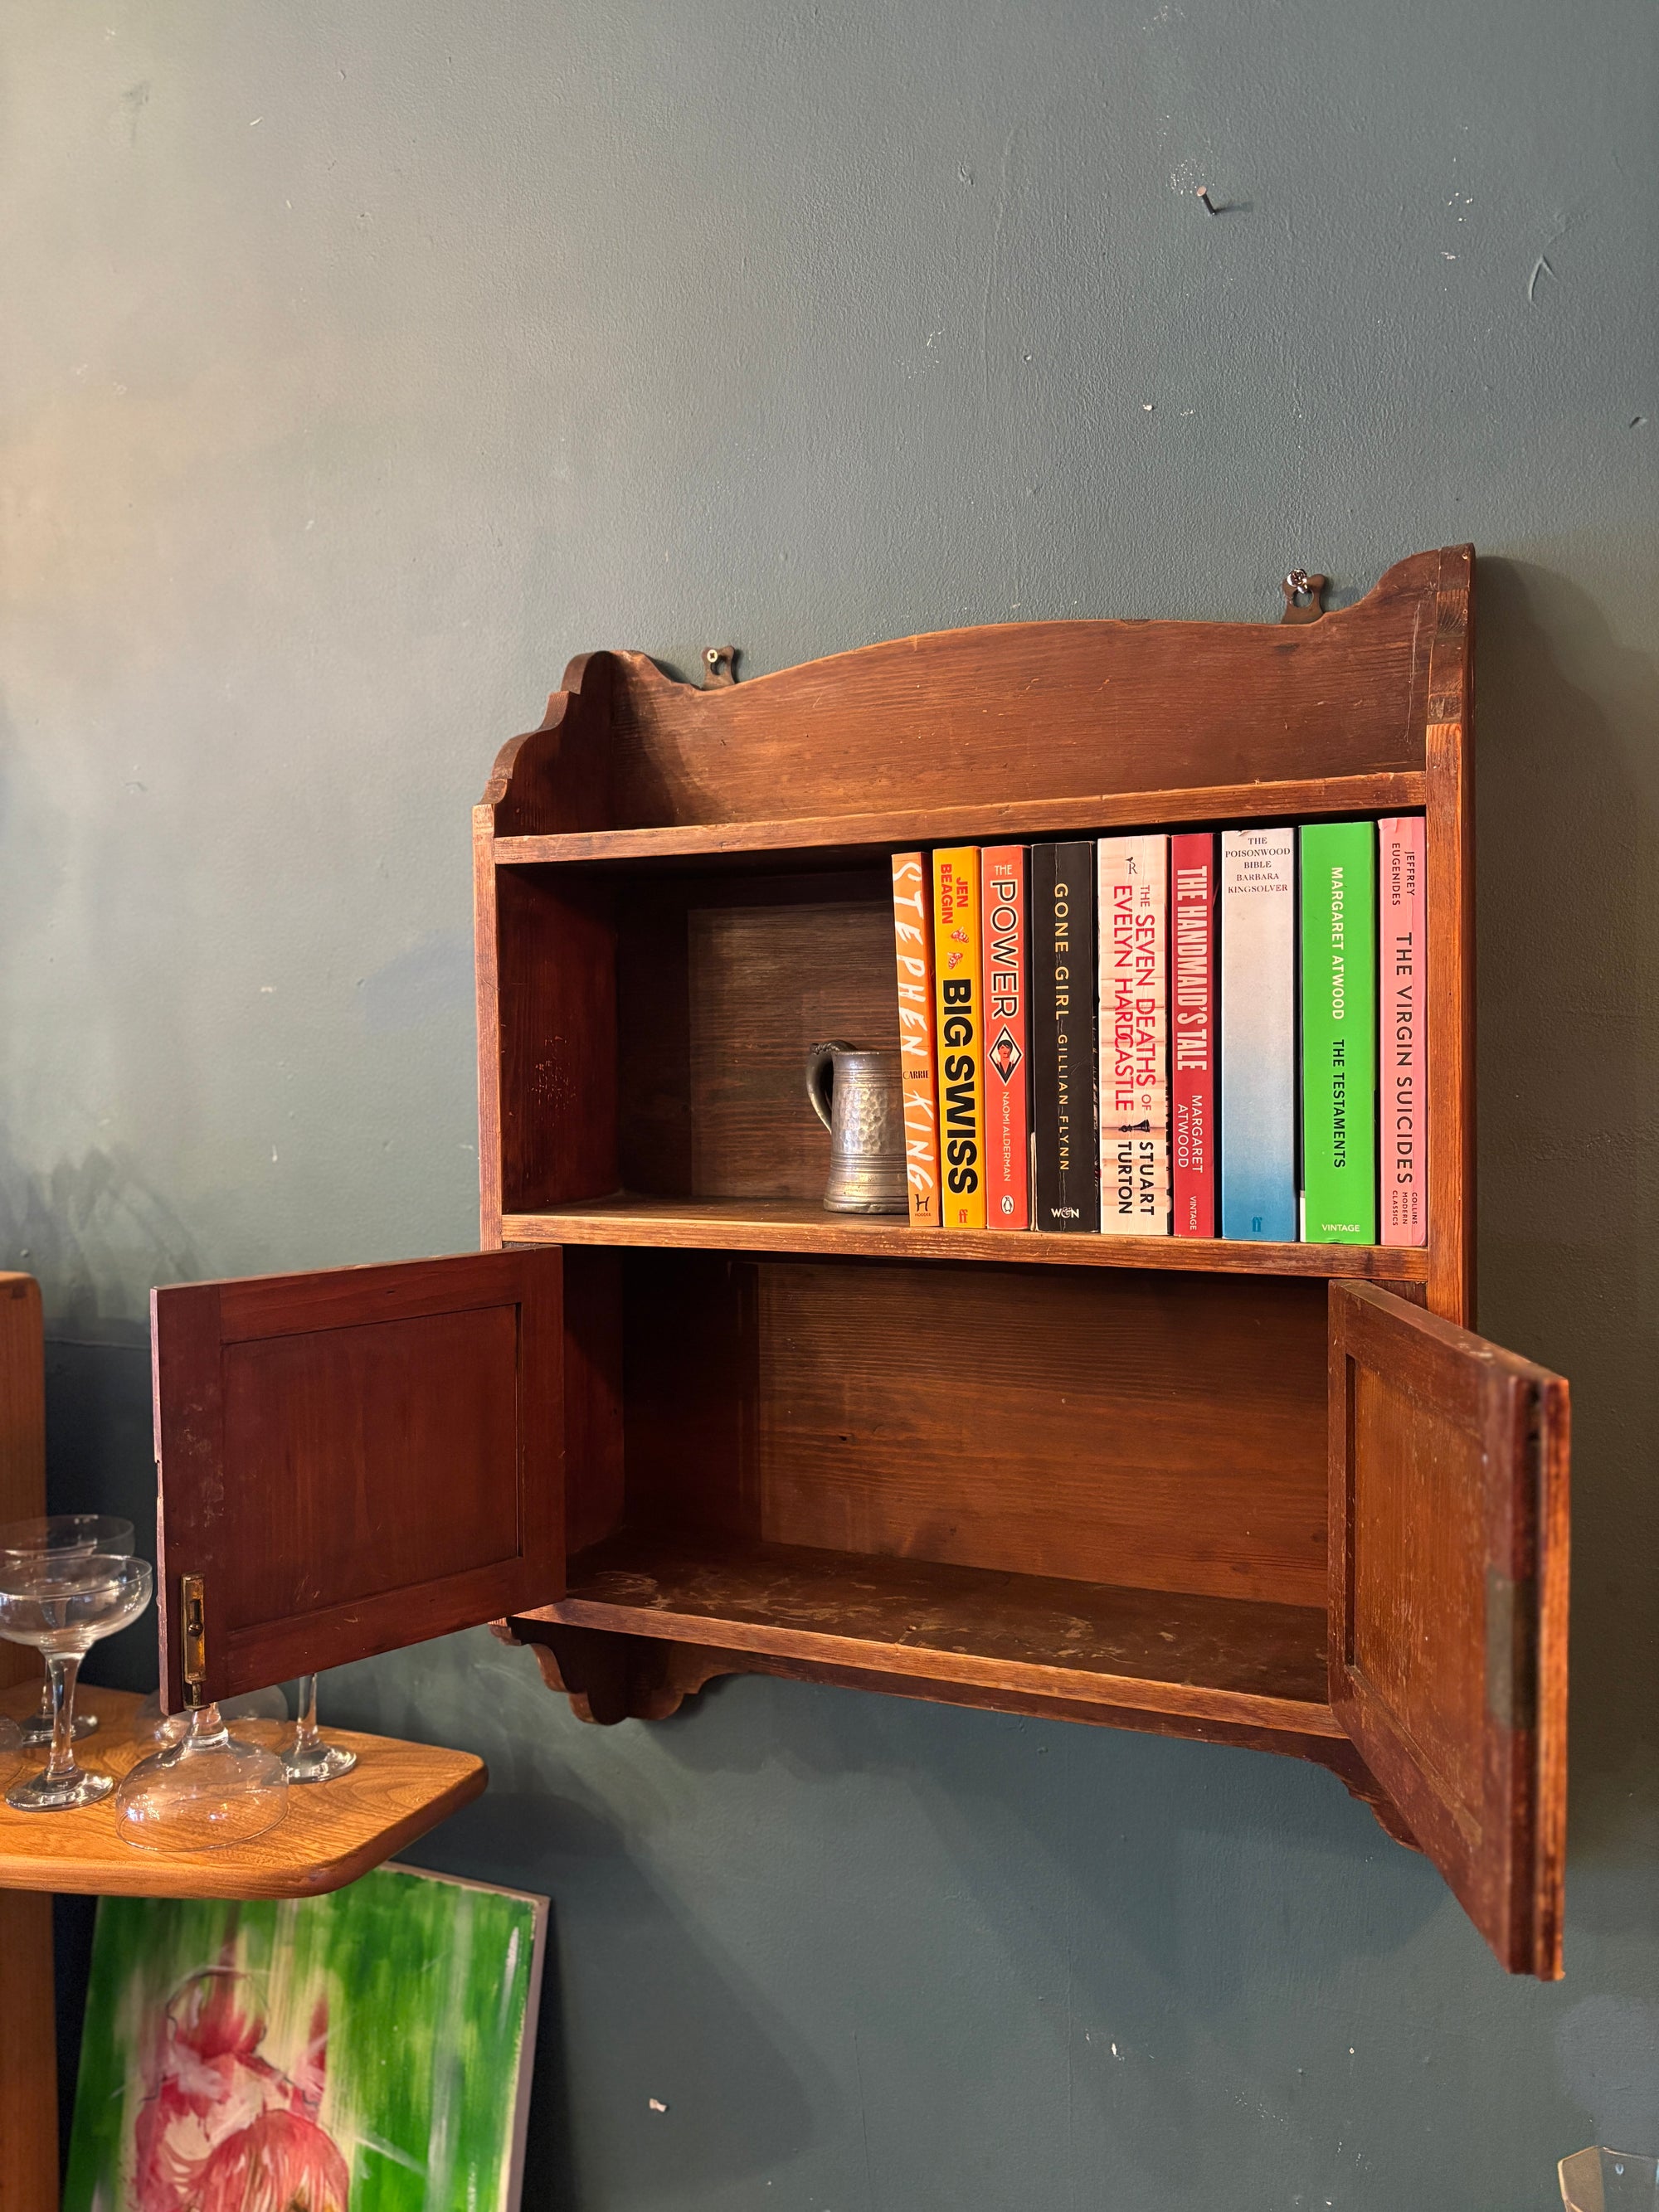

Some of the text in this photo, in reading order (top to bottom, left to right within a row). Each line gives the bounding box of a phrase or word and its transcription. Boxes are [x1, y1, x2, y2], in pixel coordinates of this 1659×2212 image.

[995, 865, 1012, 876] THE
[1225, 848, 1291, 858] POISONWOOD
[1236, 873, 1279, 882] BARBARA
[1243, 861, 1272, 869] BIBLE
[1248, 837, 1268, 845] THE
[1392, 843, 1401, 906] EUGENIDES
[1404, 851, 1415, 897] JEFFREY
[941, 863, 953, 924] BEAGIN
[956, 877, 968, 908] JEN
[1228, 884, 1288, 893] KINGSOLVER
[990, 879, 1019, 1020] POWER
[1054, 882, 1069, 1020] GONE GIRL
[1177, 866, 1208, 1071] THE HANDMAID'S TALE
[1331, 867, 1345, 1020] MARGARET ATWOOD
[893, 862, 934, 1191] STEPHEN KING
[1113, 885, 1134, 1111] EVELYN HARDCASTLE
[1136, 885, 1156, 1111] THE SEVEN DEATHS OF
[943, 979, 978, 1194] BIG SWISS
[1396, 932, 1413, 1184] THE VIRGIN SUICIDES
[1002, 1091, 1011, 1182] NAOMI ALDERMAN
[1058, 1034, 1069, 1170] GILLIAN FLYNN
[1177, 1104, 1190, 1169] ATWOOD
[1191, 1095, 1204, 1174] MARGARET
[1332, 1039, 1345, 1168] THE TESTAMENTS
[1050, 1206, 1080, 1218] W&N
[1117, 1141, 1133, 1214] TURTON
[1139, 1141, 1155, 1216] STUART
[1321, 1223, 1360, 1232] VINTAGE
